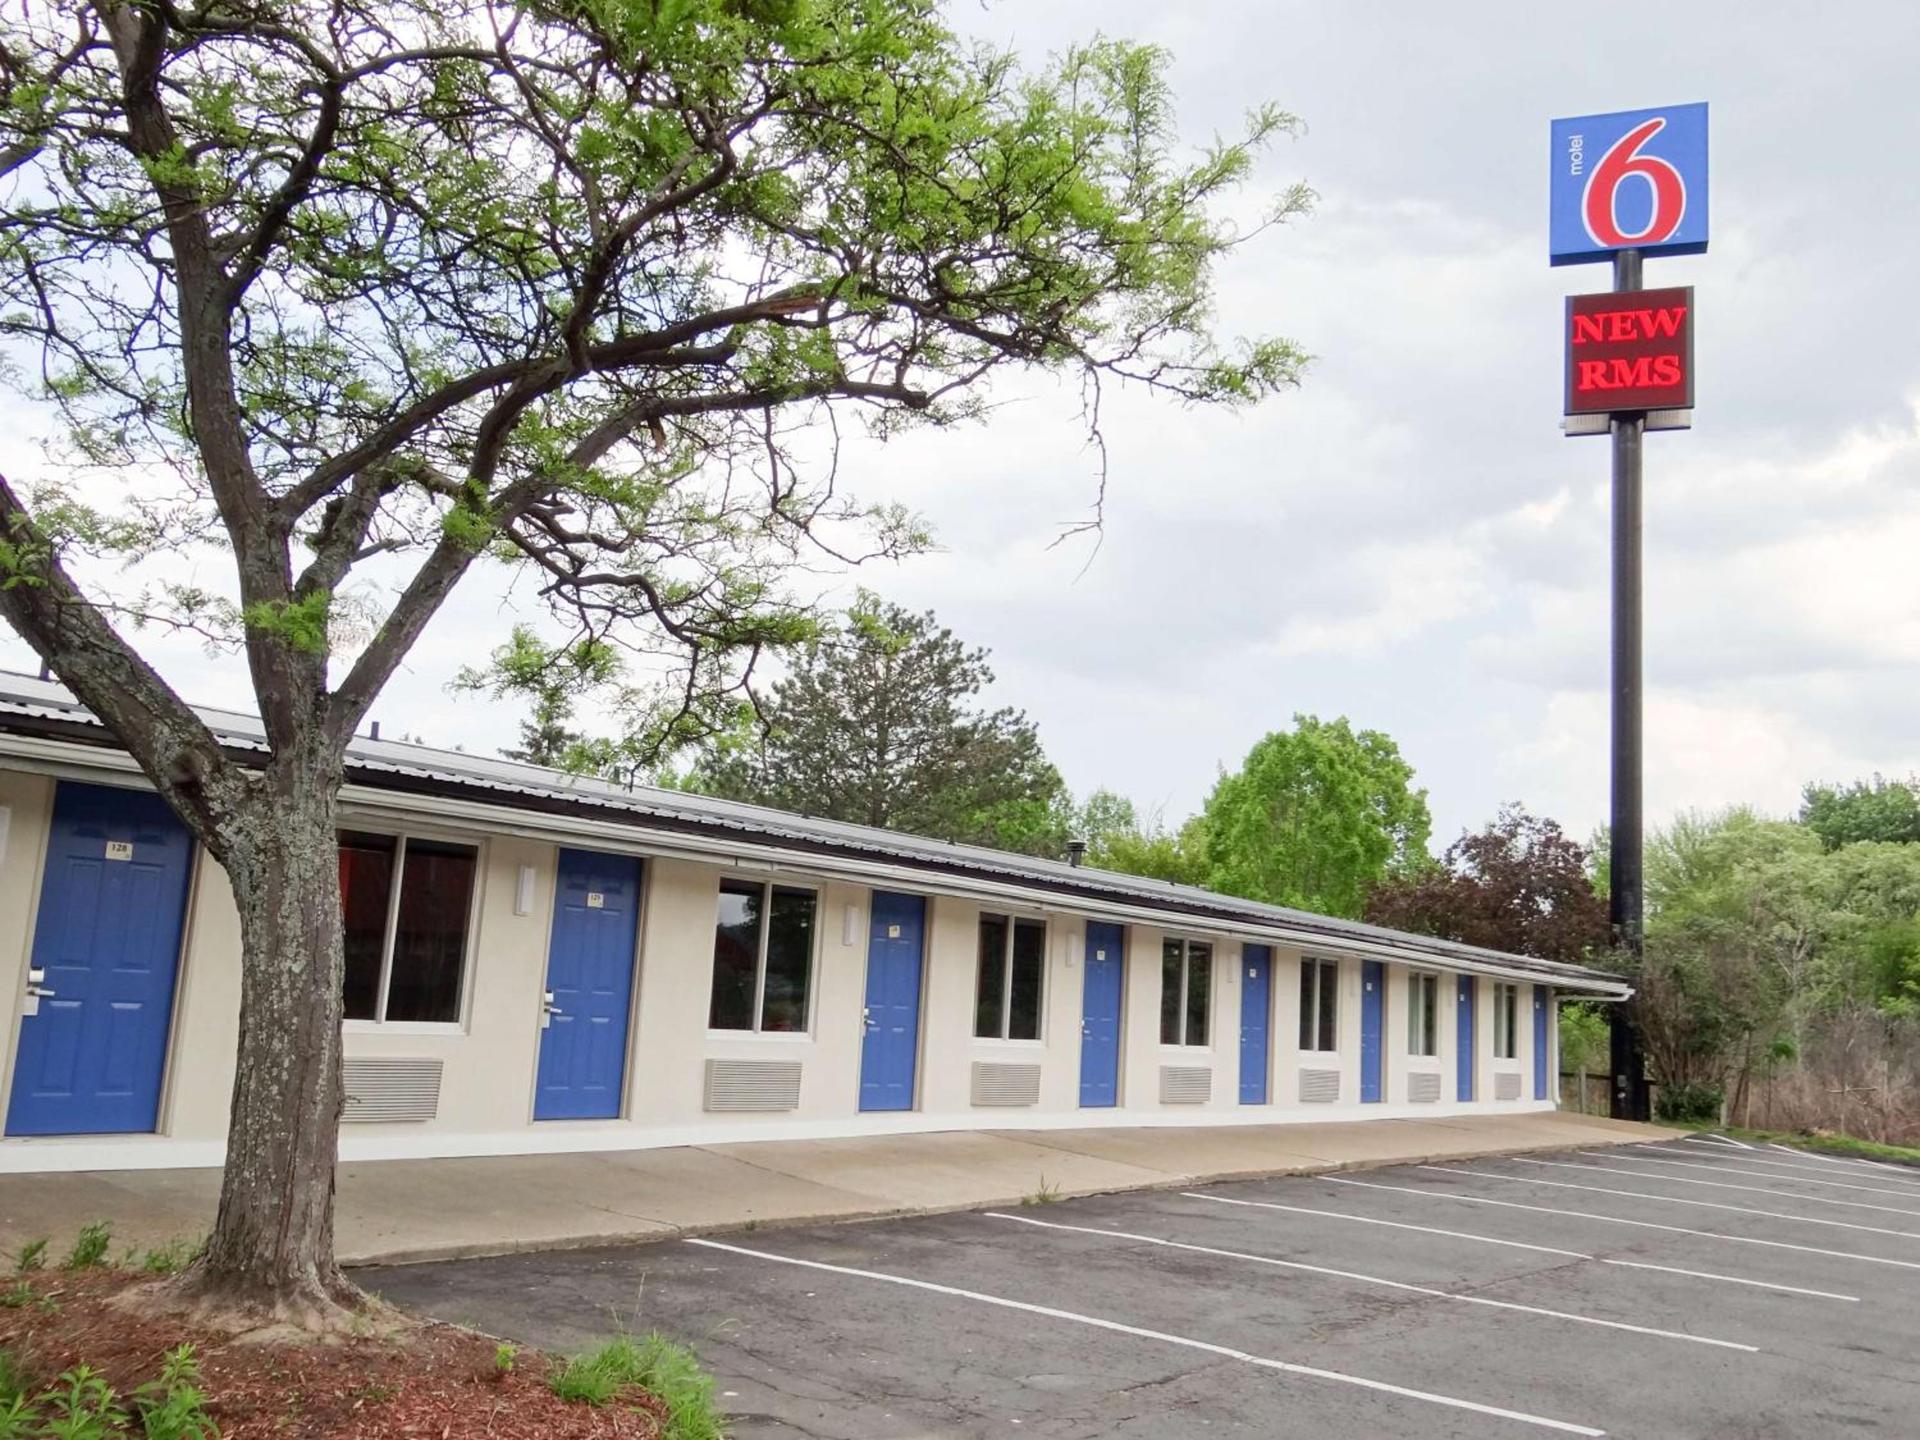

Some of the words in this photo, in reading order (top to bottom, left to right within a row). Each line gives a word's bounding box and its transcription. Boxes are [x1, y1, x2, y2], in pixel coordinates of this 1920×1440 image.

[1569, 135, 1583, 176] motel
[1581, 117, 1687, 247] 6
[1572, 307, 1687, 344] NEW
[1578, 355, 1681, 390] RMS
